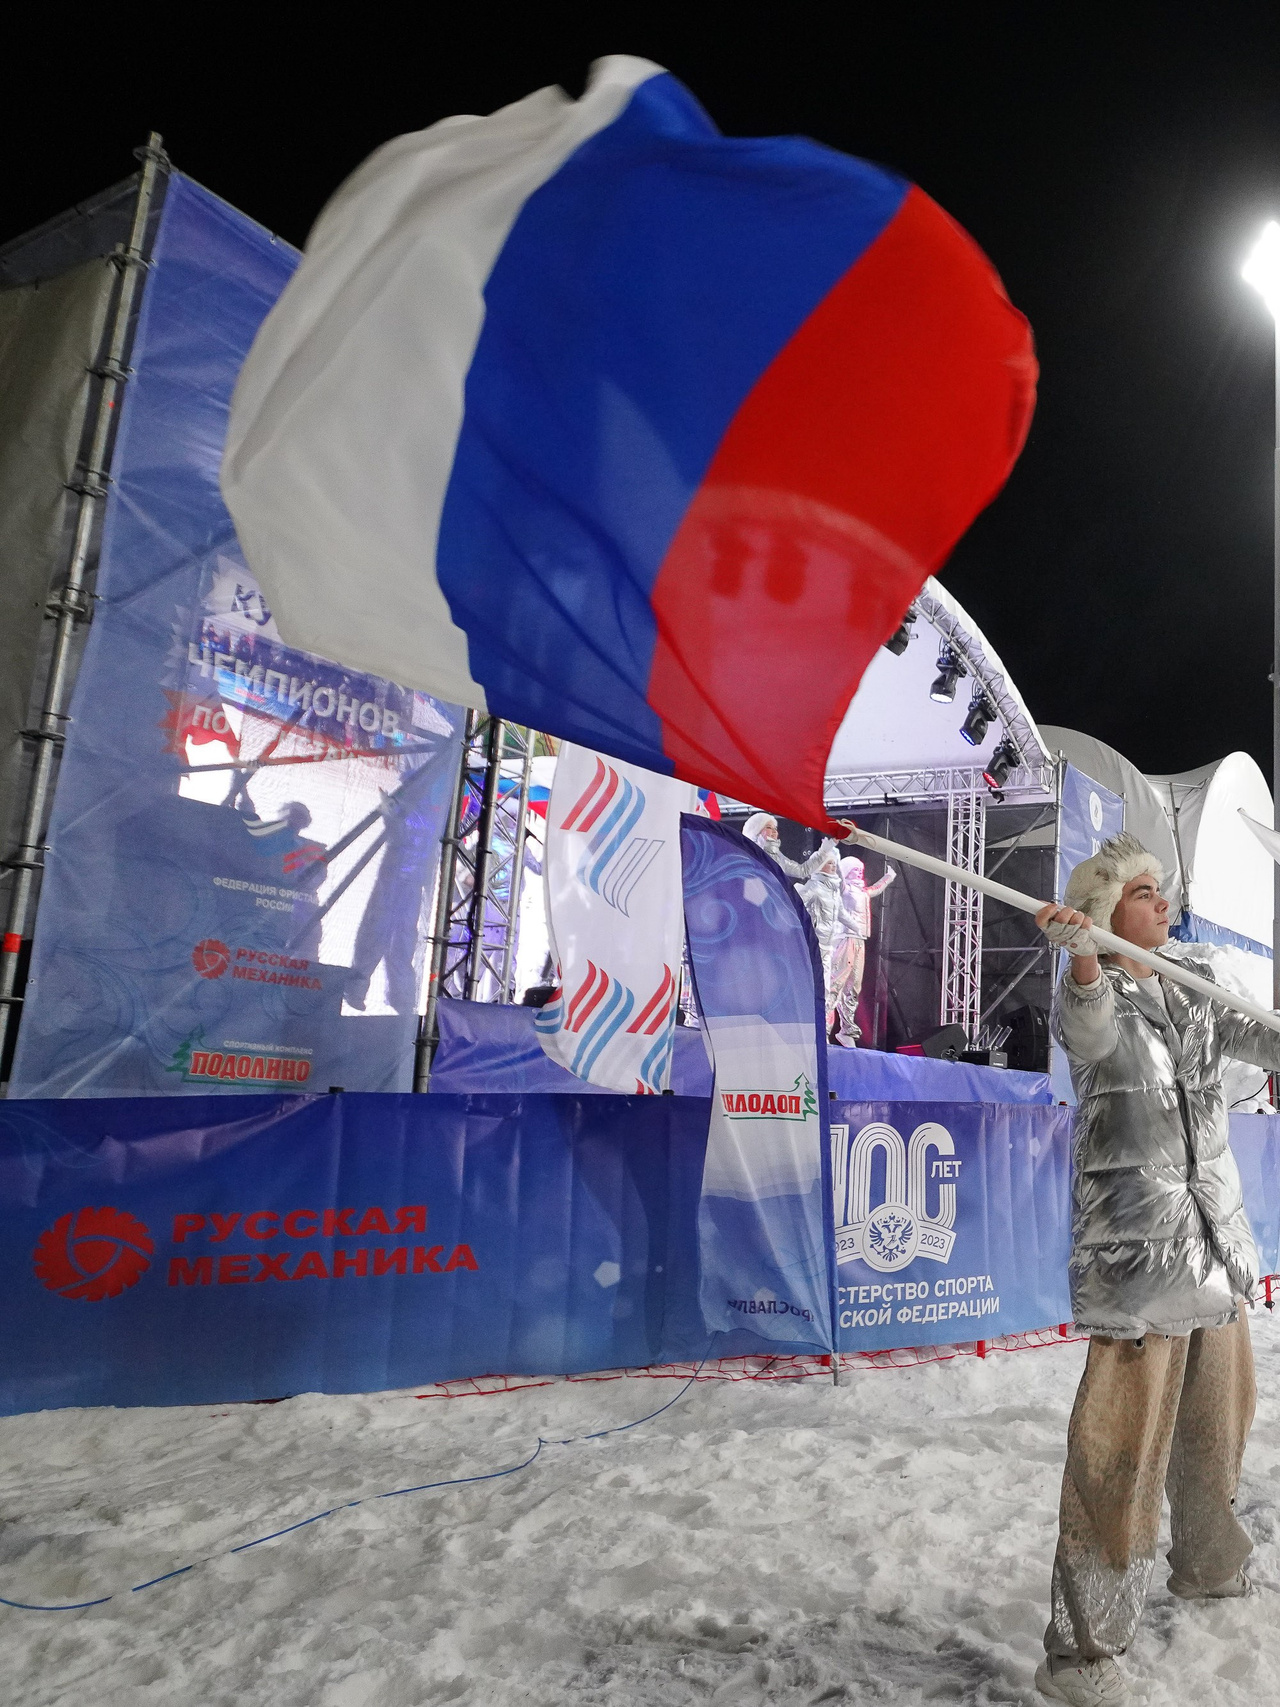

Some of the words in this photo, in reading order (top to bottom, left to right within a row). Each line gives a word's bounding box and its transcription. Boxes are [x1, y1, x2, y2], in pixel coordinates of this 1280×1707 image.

[187, 642, 402, 738] ЧЕМПИОНОВ
[212, 876, 277, 897] ФЕДЕРАЦИЯ
[235, 947, 310, 971] РУССКАЯ
[231, 965, 323, 991] МЕХАНИКА
[930, 1160, 962, 1179] ЛЕТ
[172, 1205, 428, 1243] РУССКАЯ
[920, 1233, 946, 1250] 2023
[167, 1244, 479, 1287] МЕХАНИКА
[934, 1275, 994, 1297] СПОРТА
[896, 1296, 1000, 1325] ФЕДЕРАЦИИ
